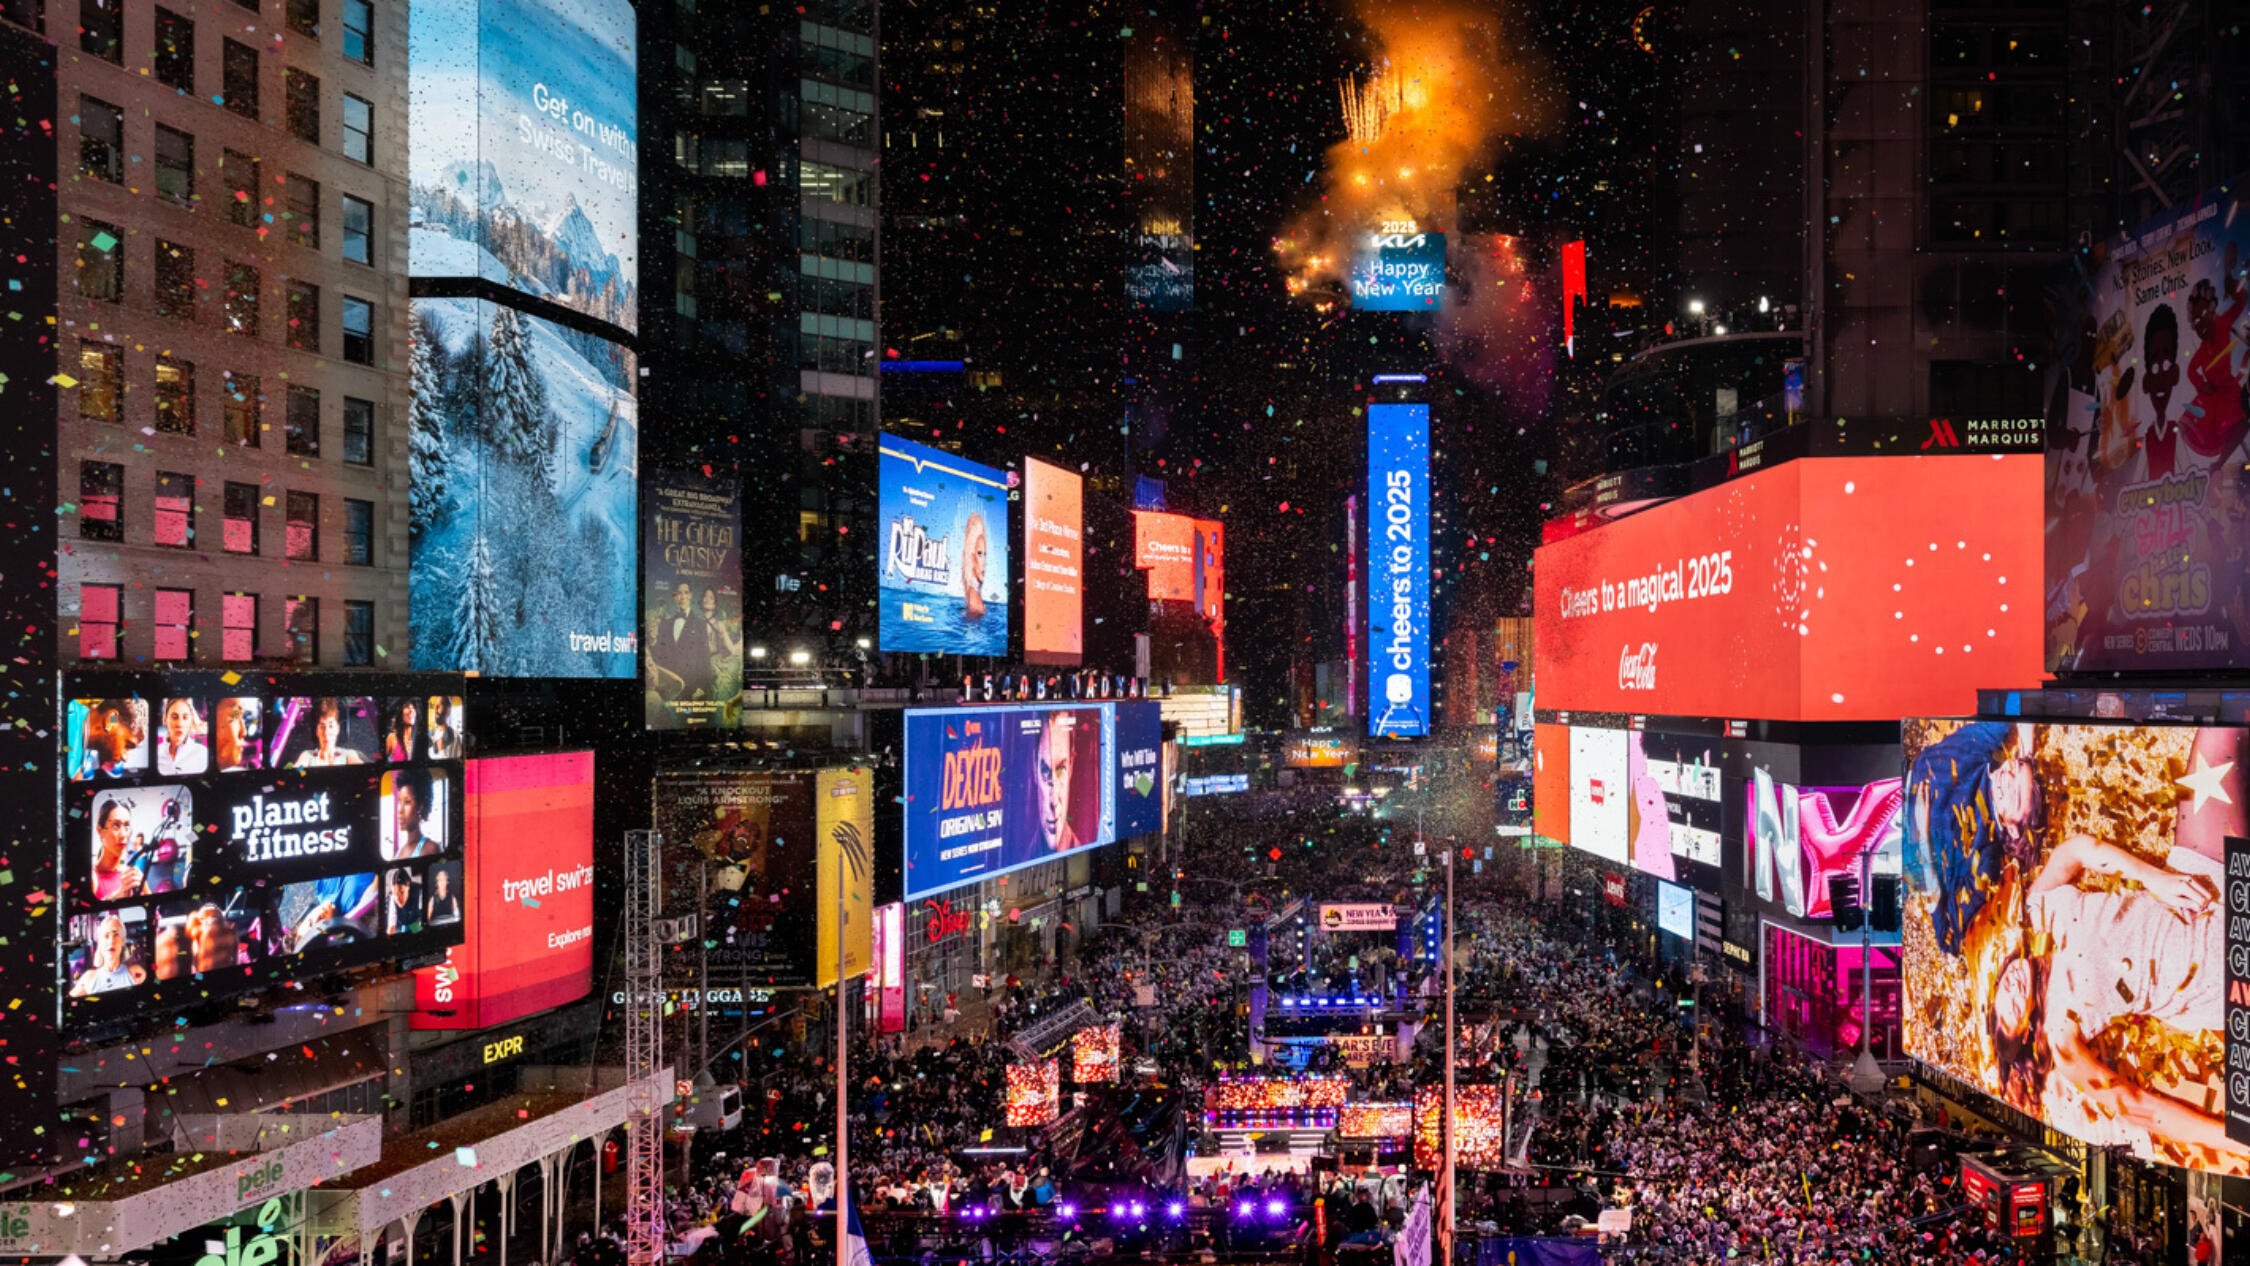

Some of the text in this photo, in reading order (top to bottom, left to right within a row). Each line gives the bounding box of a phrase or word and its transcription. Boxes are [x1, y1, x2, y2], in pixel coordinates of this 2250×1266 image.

[533, 83, 568, 119] Get
[572, 111, 595, 137] on
[599, 123, 630, 159] with
[519, 114, 575, 164] Swiss
[580, 144, 627, 193] Travel
[1382, 221, 1417, 234] 2025
[1371, 261, 1428, 280] Happy
[2167, 248, 2187, 270] New
[1355, 279, 1445, 297] New Year
[2136, 284, 2159, 306] Same
[1968, 433, 2039, 445] MARQUIS
[1386, 470, 1412, 670] cheers to 2025
[1560, 550, 1733, 618] Cheers to a magical 2025
[569, 630, 611, 653] travel
[711, 785, 771, 795] KNOCKOUT
[942, 745, 1003, 811] DEXTER
[231, 792, 330, 840] planet
[940, 809, 1003, 838] ORIGINAL SIN
[502, 868, 552, 903] travel
[924, 899, 970, 943] Disney
[548, 928, 581, 949] Explore
[483, 1035, 523, 1064] EXPR
[1453, 1137, 1490, 1152] 025
